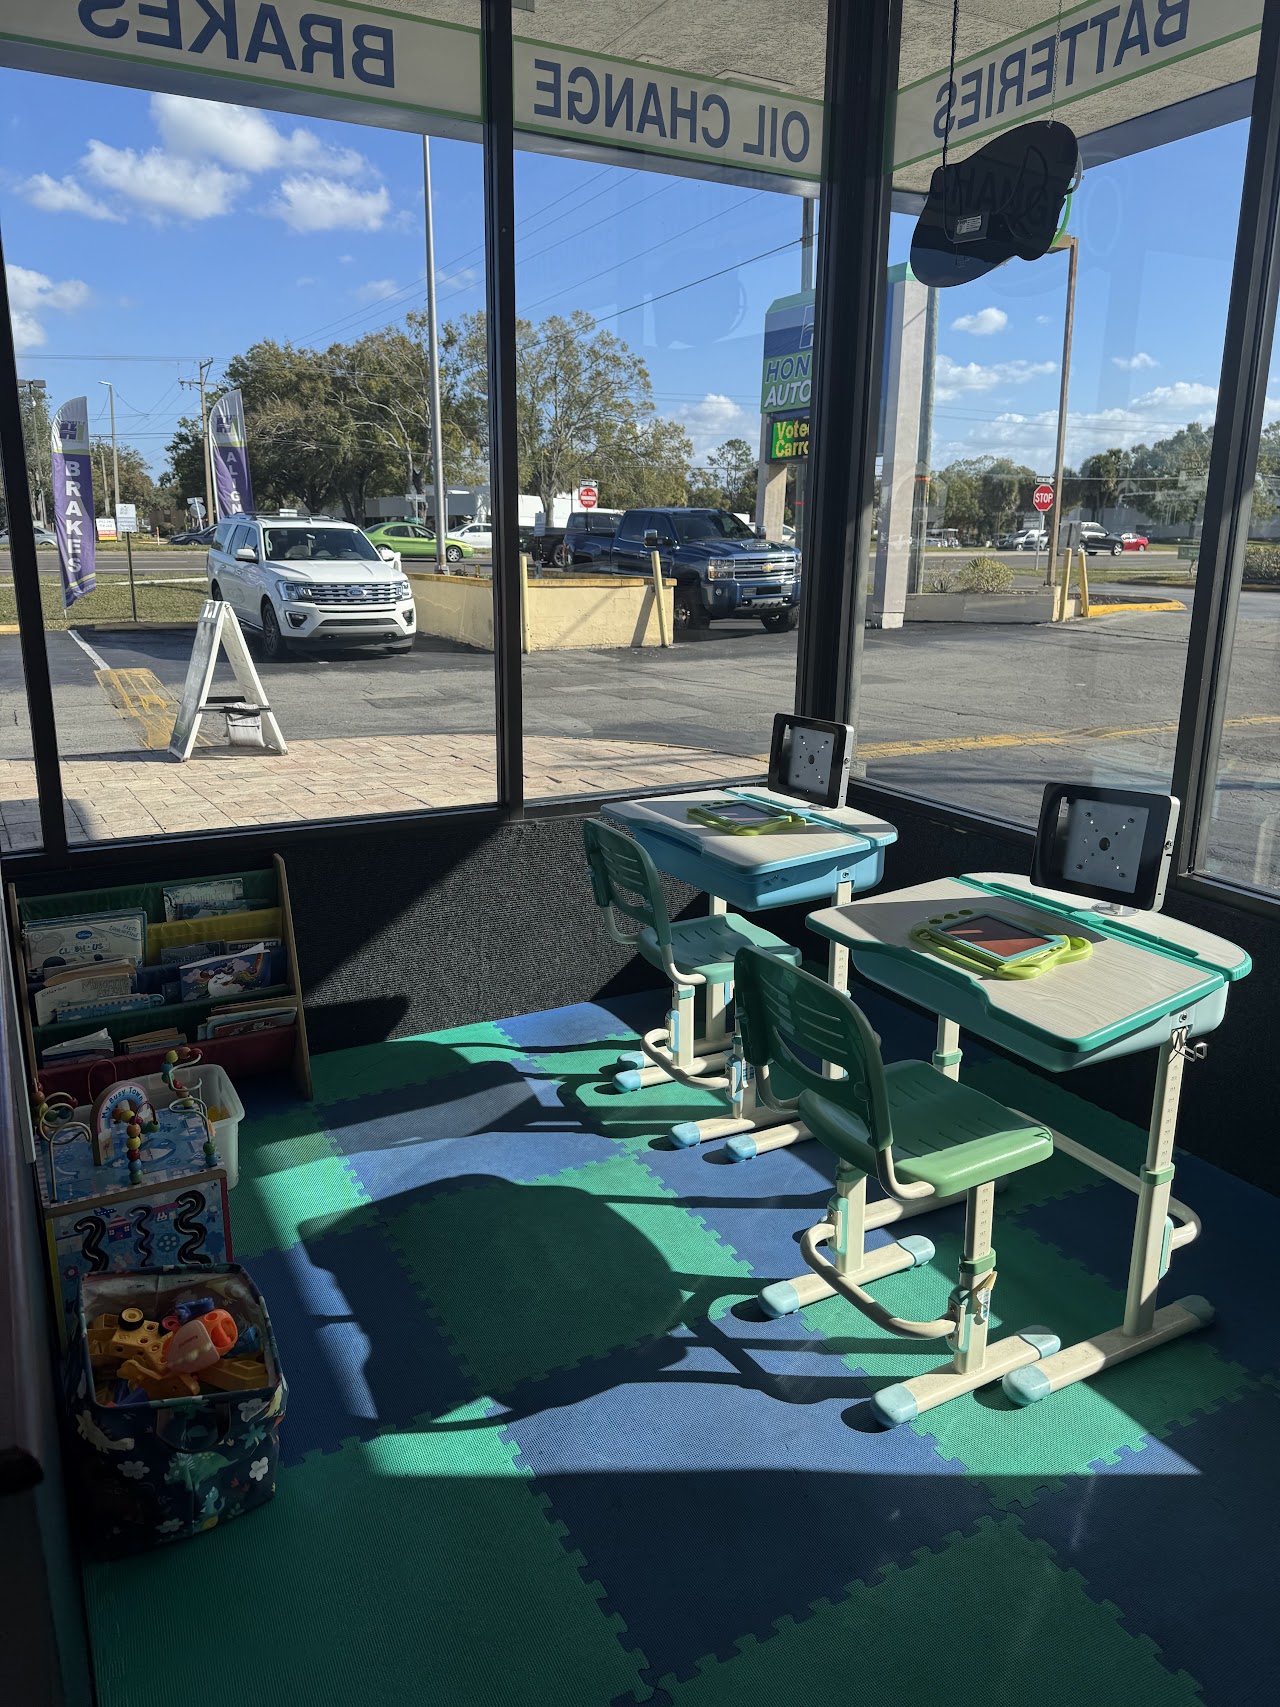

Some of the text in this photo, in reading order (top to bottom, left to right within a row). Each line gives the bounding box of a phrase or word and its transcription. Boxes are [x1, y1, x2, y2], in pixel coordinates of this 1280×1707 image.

[763, 379, 812, 408] AUTO
[776, 419, 810, 440] Vote
[1035, 492, 1054, 504] STOP
[65, 460, 83, 574] BRAKES
[101, 1086, 144, 1119] My Busy Town
